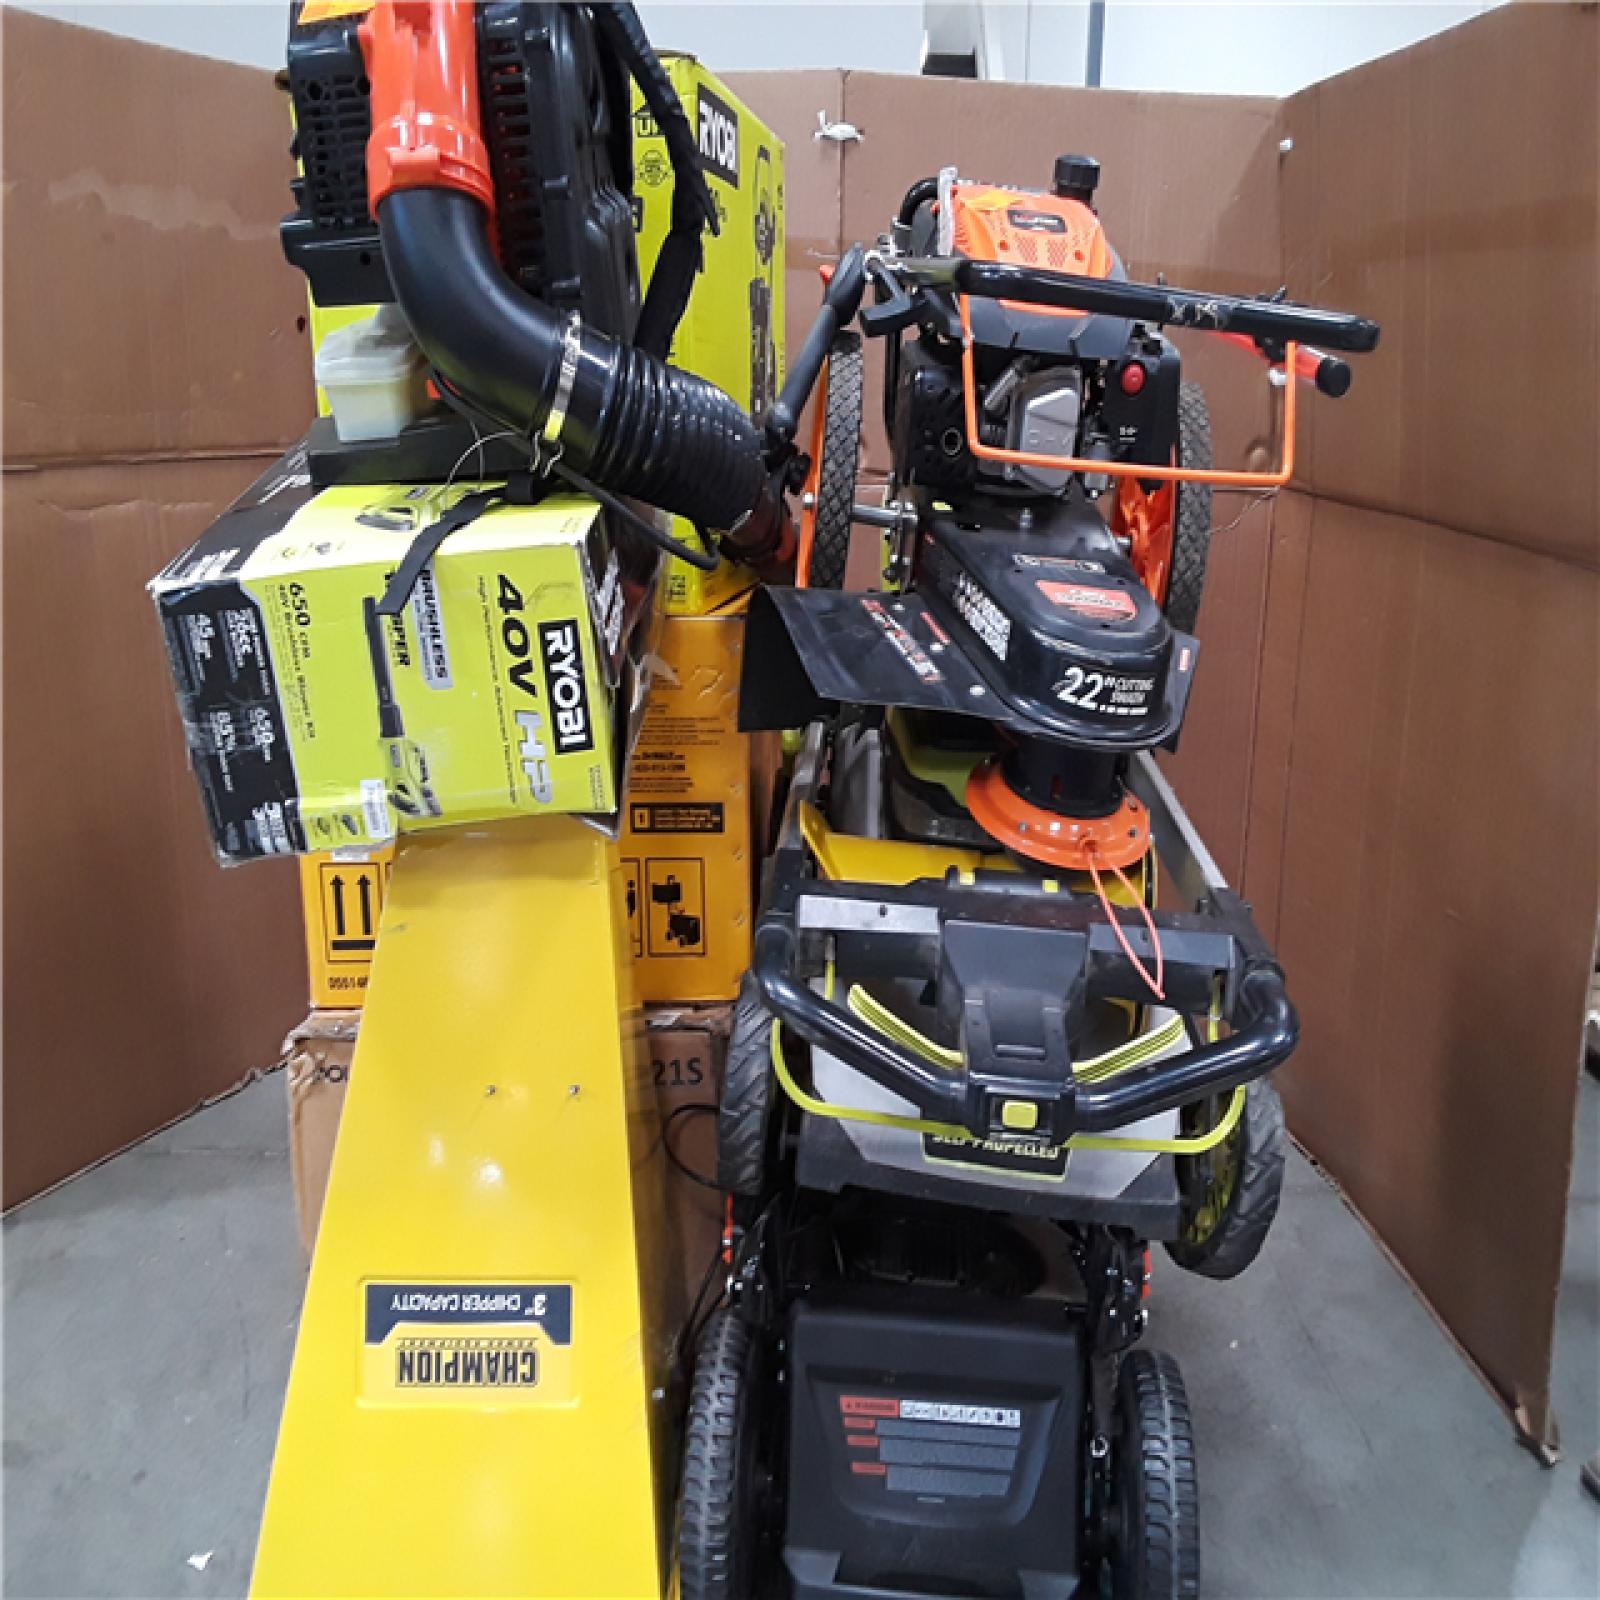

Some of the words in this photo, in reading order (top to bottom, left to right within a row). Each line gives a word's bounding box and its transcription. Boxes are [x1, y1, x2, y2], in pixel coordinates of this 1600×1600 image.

[700, 99, 737, 174] RYOBI
[290, 581, 311, 626] 650
[498, 574, 537, 698] 40V
[545, 626, 586, 747] RYOBI
[515, 710, 552, 804] HP
[653, 1057, 703, 1085] 21S
[390, 1294, 458, 1310] CAPACITY
[462, 1295, 521, 1310] CHIPPER
[524, 1295, 546, 1315] 3"
[399, 1351, 536, 1384] CHAMPION
